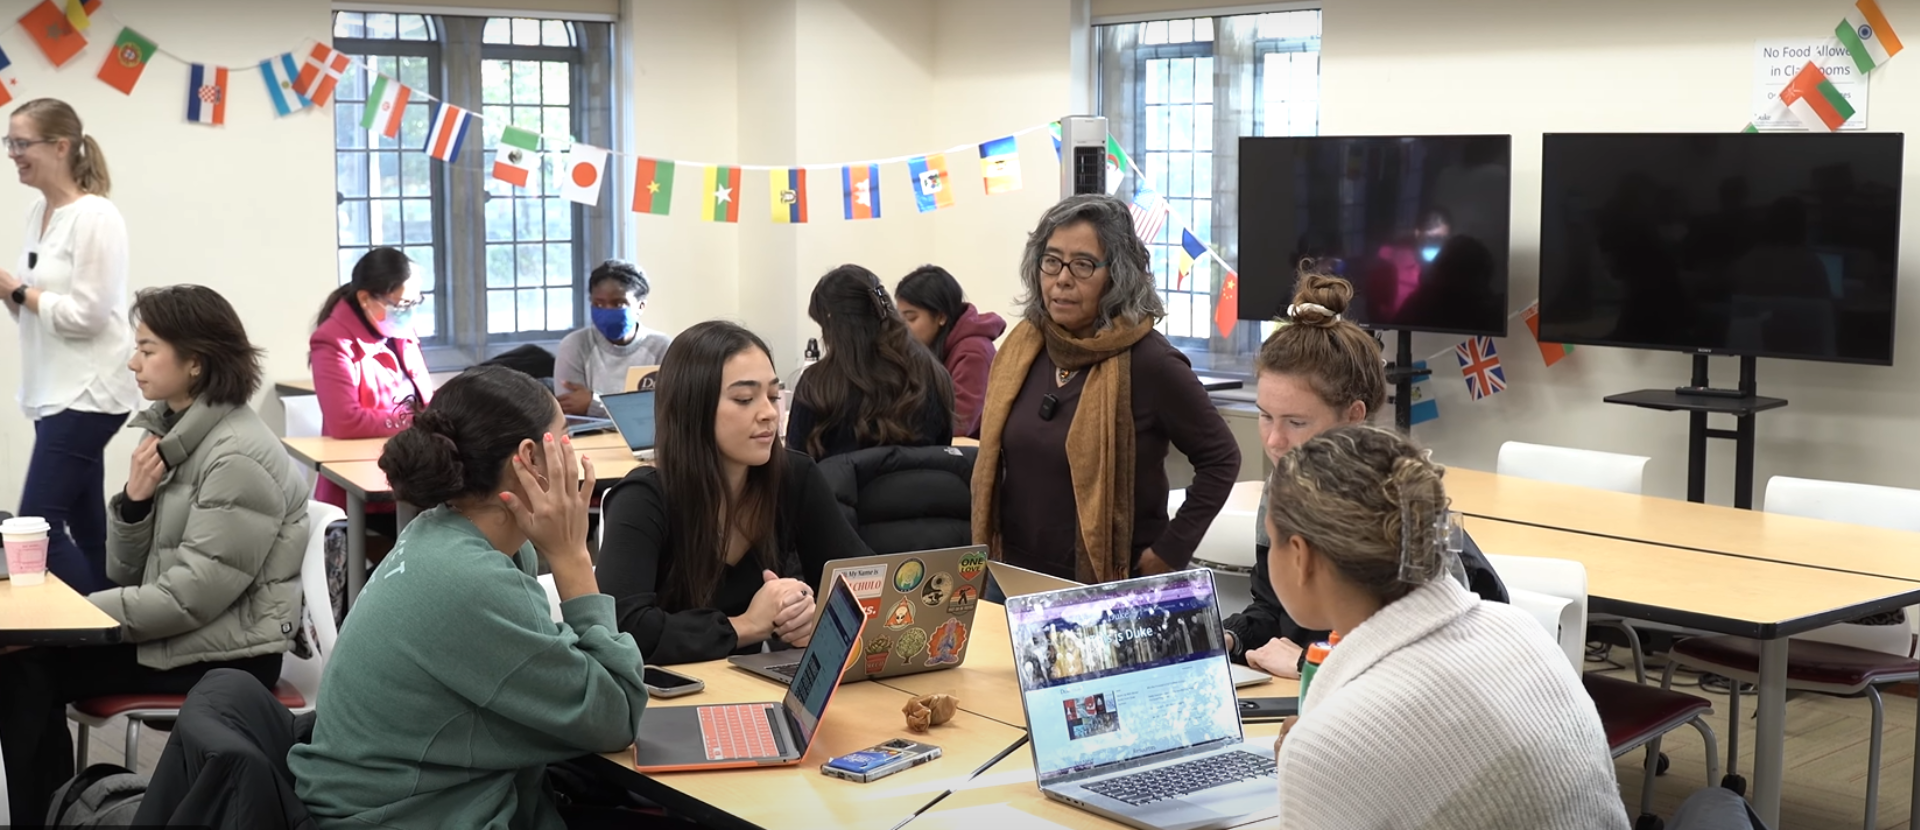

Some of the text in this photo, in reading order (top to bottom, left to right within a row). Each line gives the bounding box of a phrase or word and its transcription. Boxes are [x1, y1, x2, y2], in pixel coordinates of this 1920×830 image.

[1763, 45, 1852, 58] No Food llowe
[1771, 65, 1851, 77] in Claooms
[961, 557, 983, 567] ONE
[1125, 626, 1153, 641] Duke
